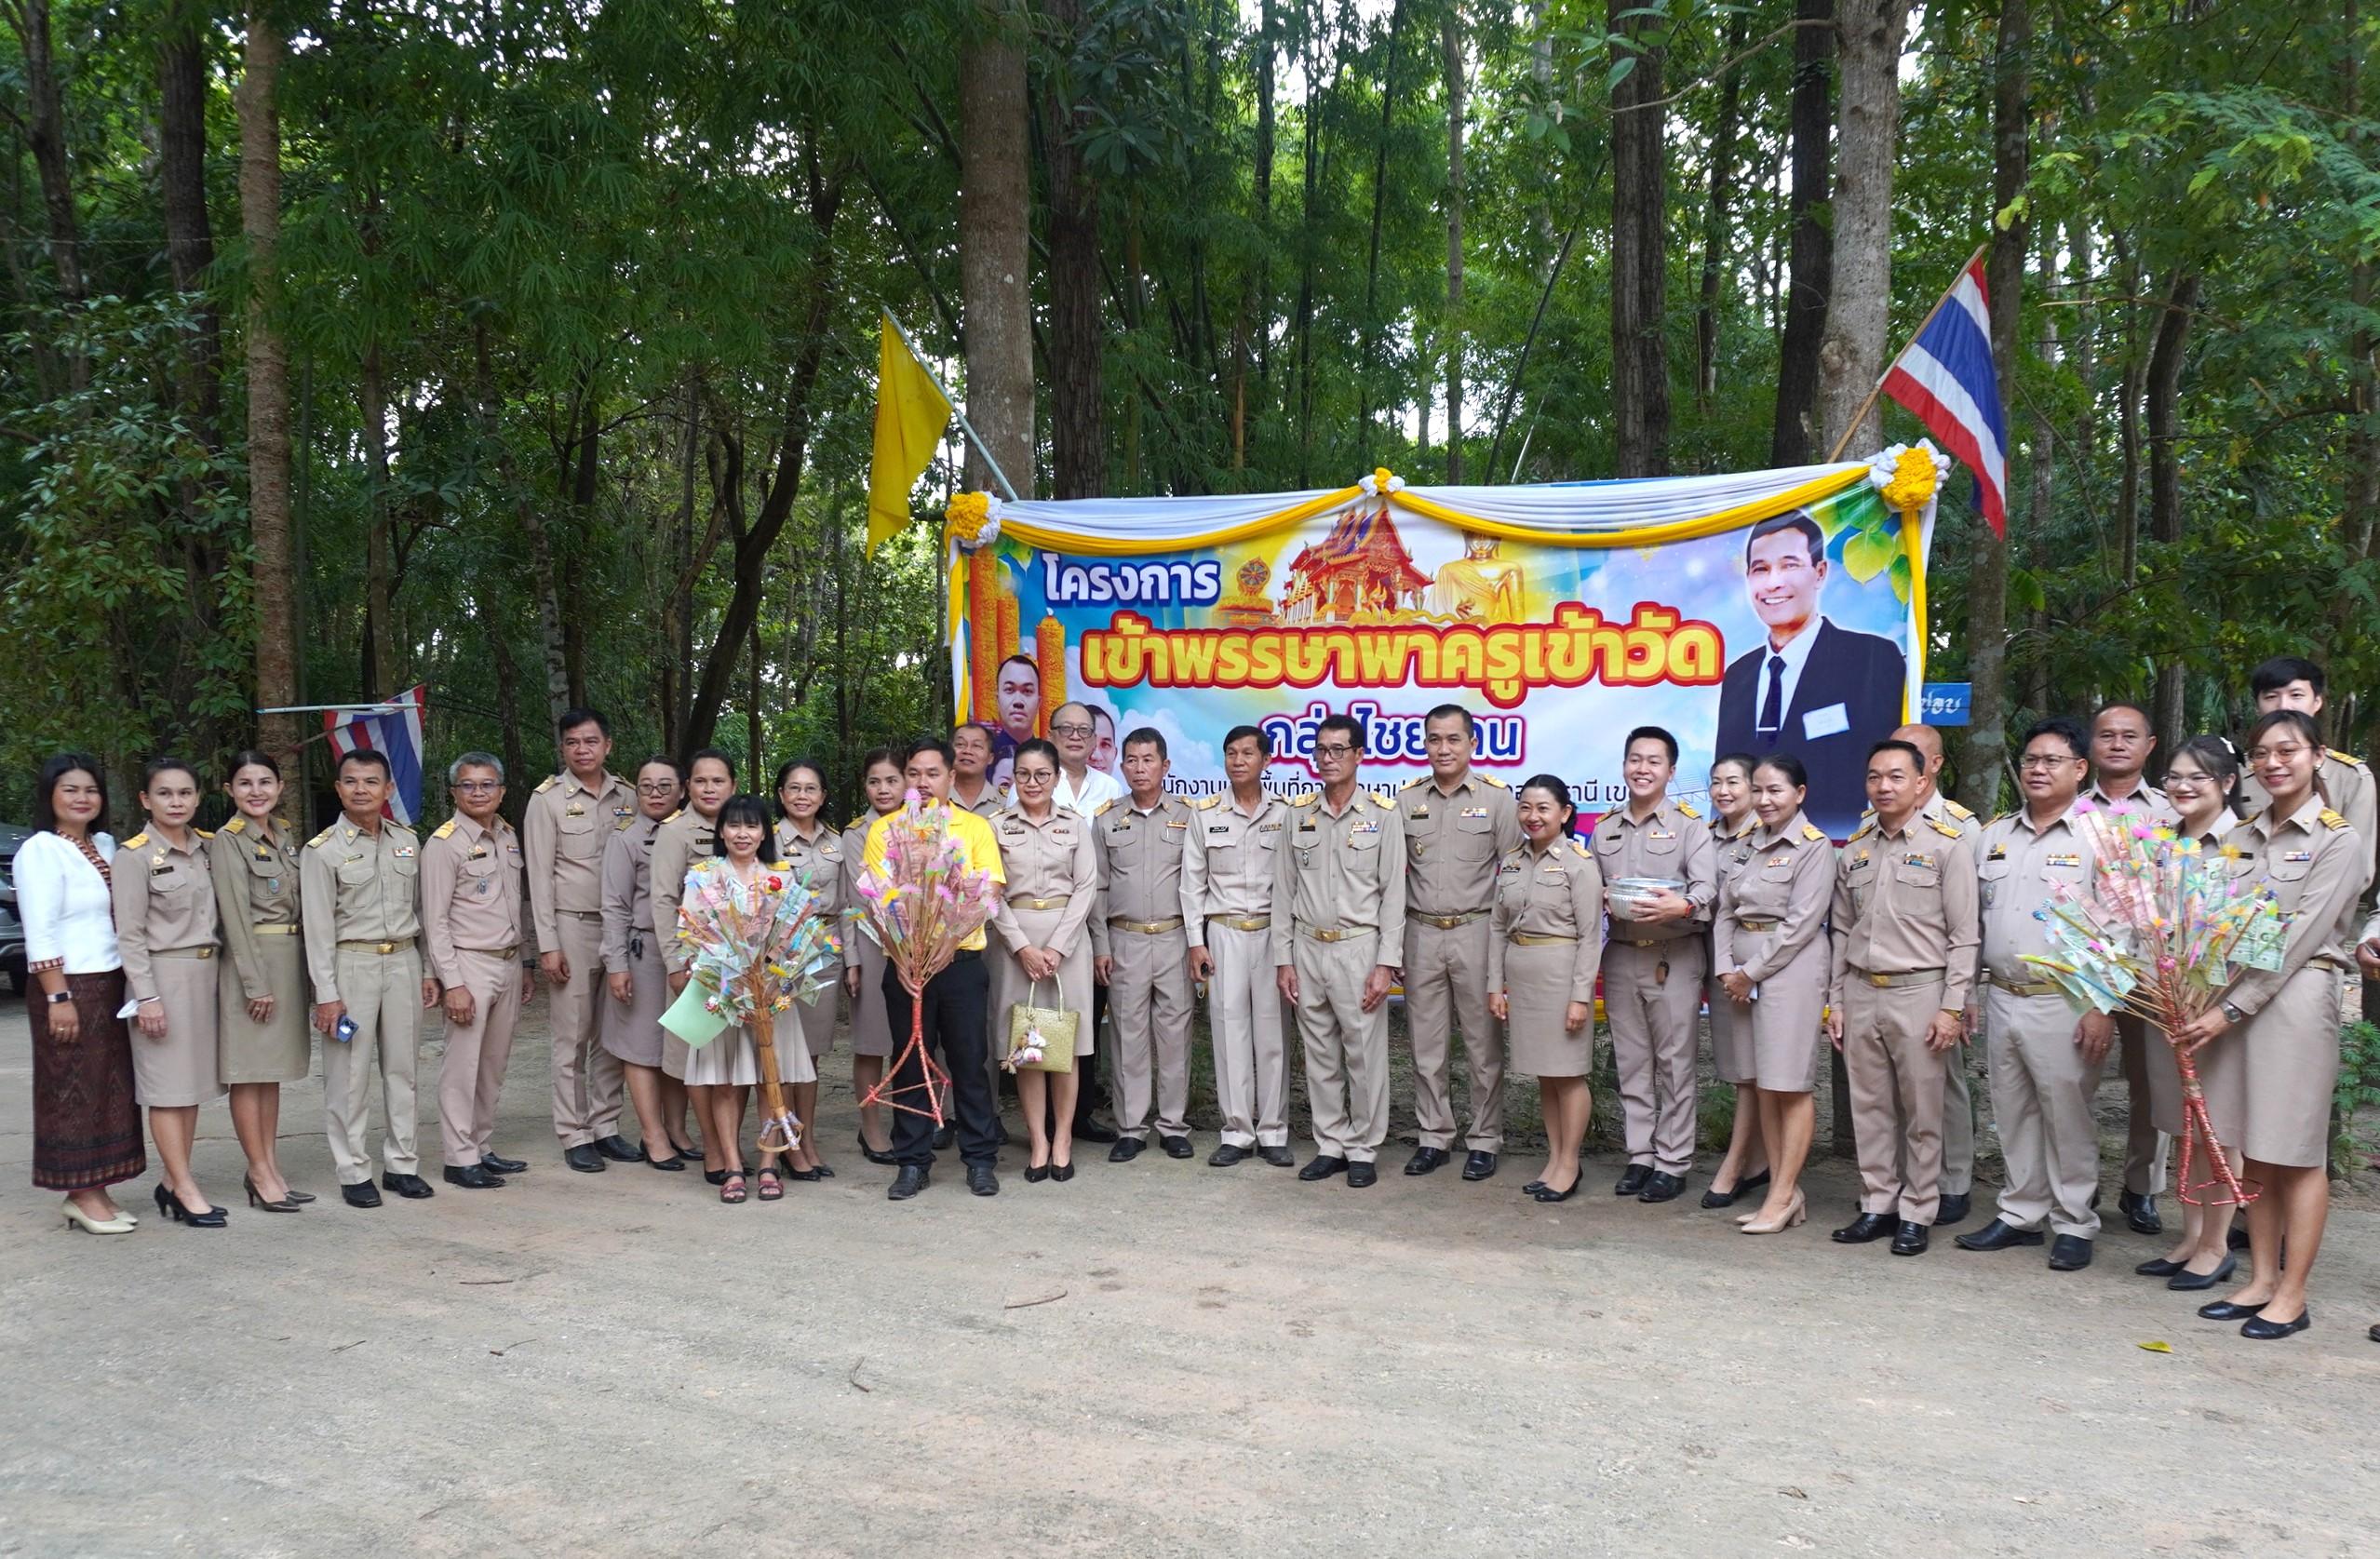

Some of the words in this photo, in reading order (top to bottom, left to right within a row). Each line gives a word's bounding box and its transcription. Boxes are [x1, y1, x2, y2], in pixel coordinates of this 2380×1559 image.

[1042, 552, 1218, 601] โครงการ
[1084, 611, 1721, 701] เข้าพรรษาพาครูเข้าวัด
